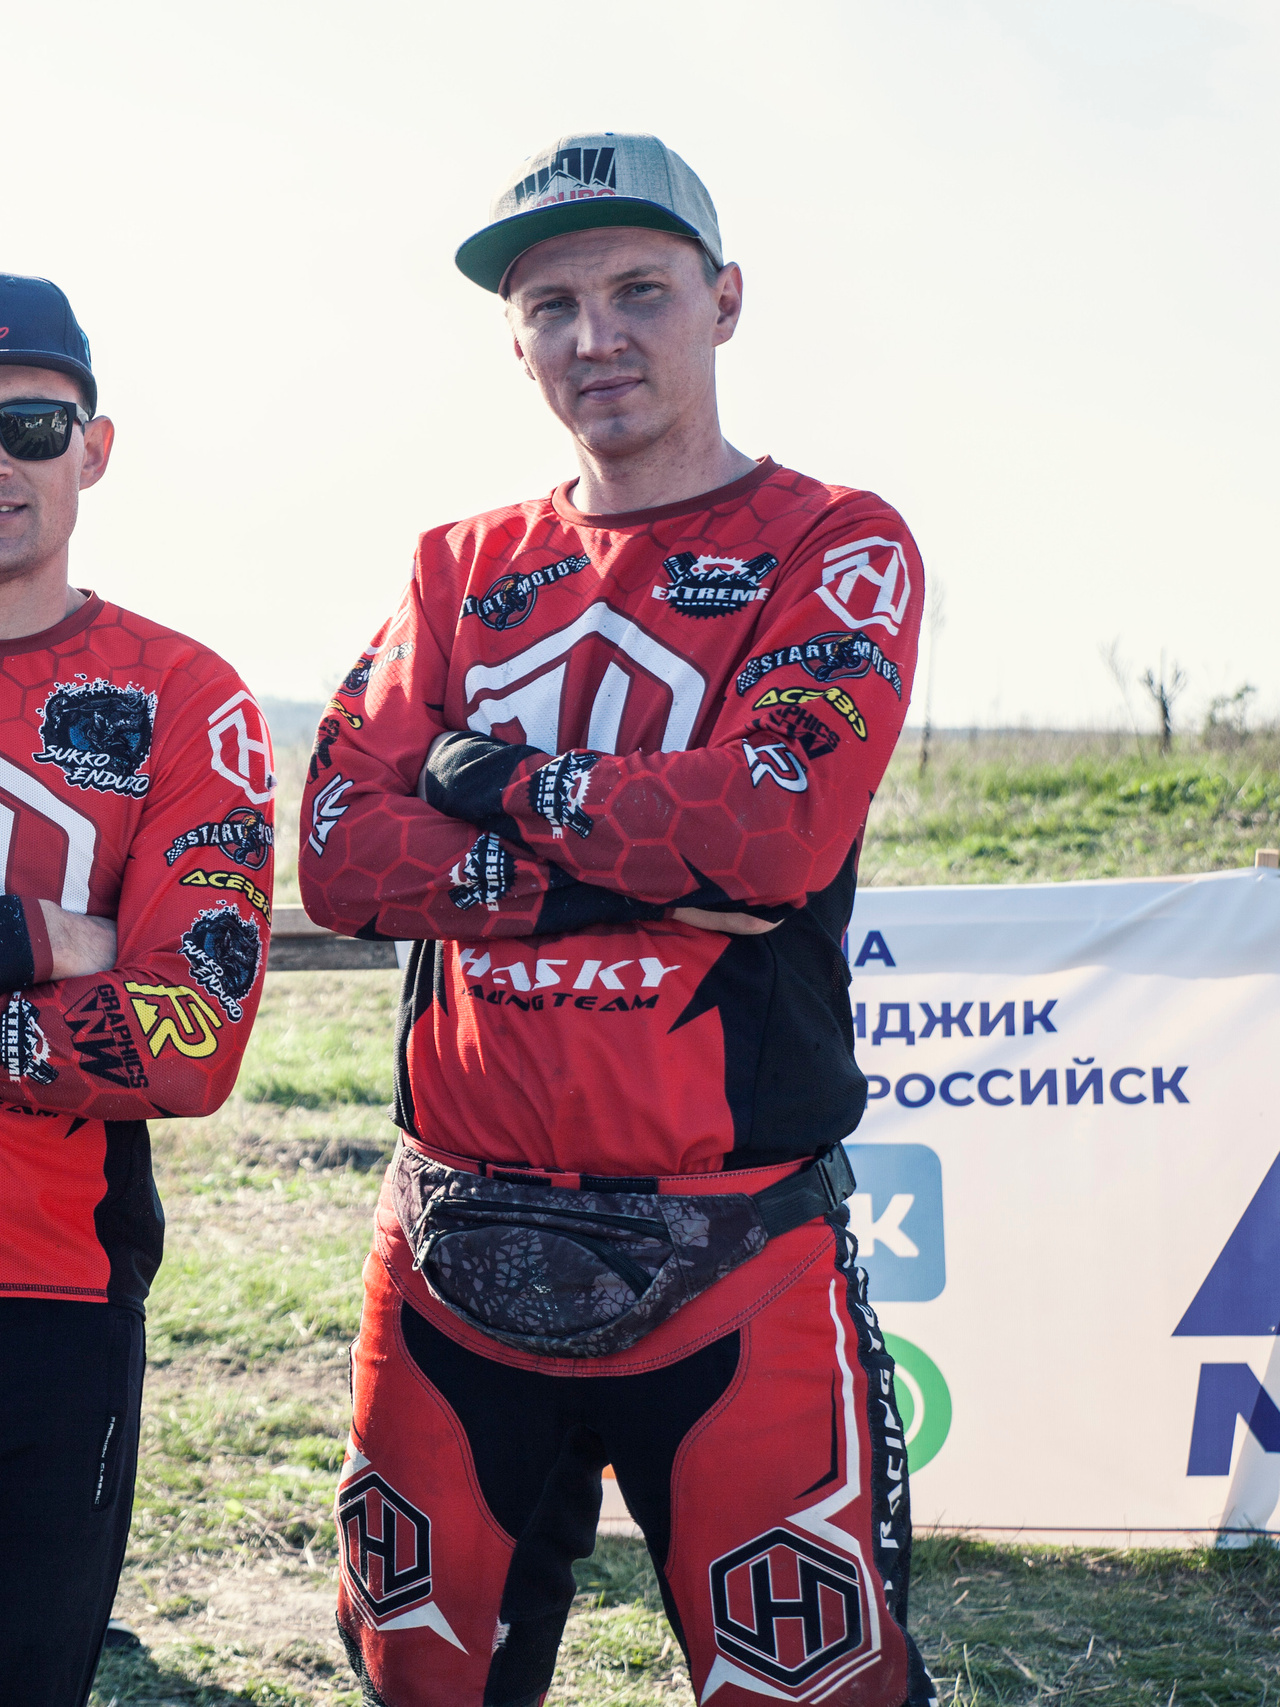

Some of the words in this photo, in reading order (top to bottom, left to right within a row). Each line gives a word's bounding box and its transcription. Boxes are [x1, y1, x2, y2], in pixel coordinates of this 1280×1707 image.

[515, 563, 570, 596] MOTO
[651, 583, 771, 602] EXTREME
[760, 642, 833, 673] START
[852, 640, 893, 679] MOTO
[38, 744, 111, 768] SUKKO
[70, 766, 150, 793] ENDURO
[542, 761, 564, 840] TREME
[186, 823, 244, 848] START
[181, 939, 225, 978] SUKKO
[460, 948, 682, 992] HASKY
[193, 966, 242, 1019] ENDURO
[551, 991, 660, 1012] TEAM
[7, 990, 22, 1083] EXTREME
[97, 983, 150, 1090] GRAPHICS
[877, 1367, 905, 1550] RACING
